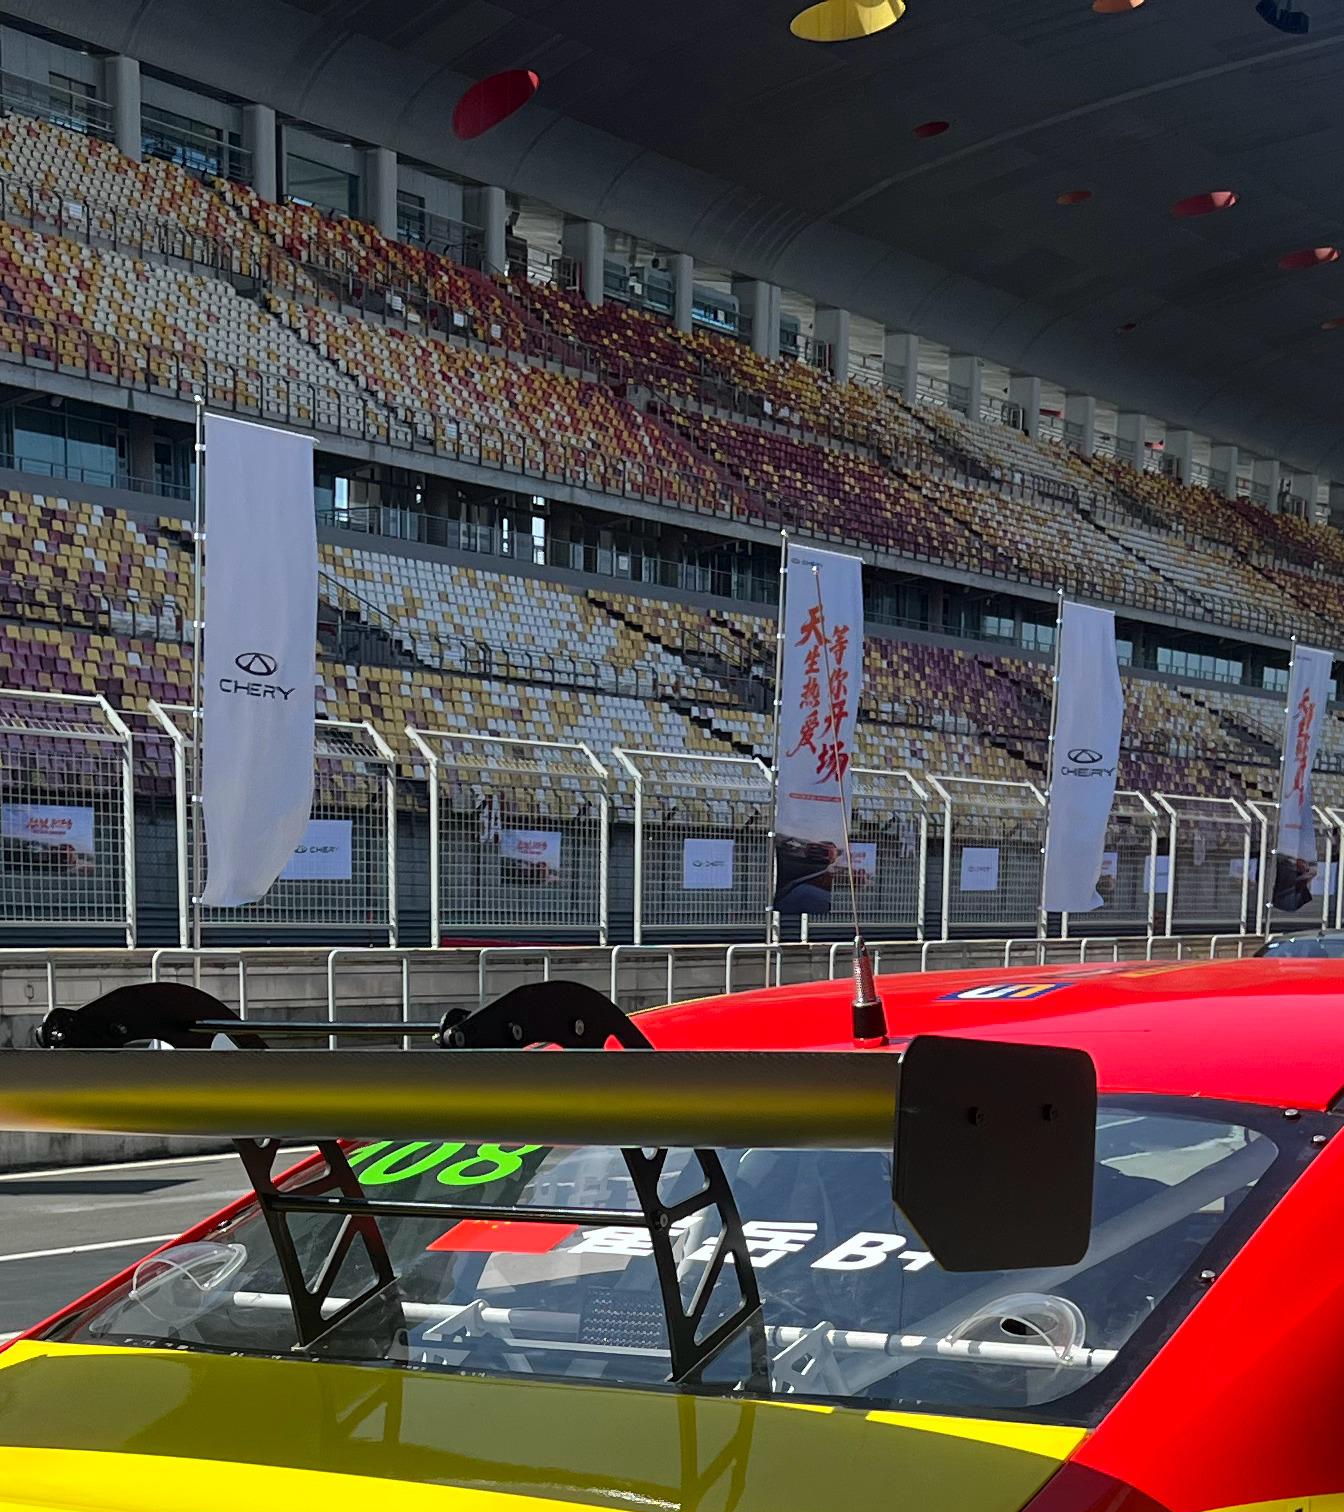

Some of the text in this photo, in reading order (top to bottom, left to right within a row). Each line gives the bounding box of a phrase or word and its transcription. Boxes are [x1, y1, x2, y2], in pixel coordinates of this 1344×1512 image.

[219, 678, 295, 700] CHERY
[787, 603, 831, 757] 天生热爱
[810, 624, 850, 786] 等你开场
[1061, 766, 1116, 778] CHERY
